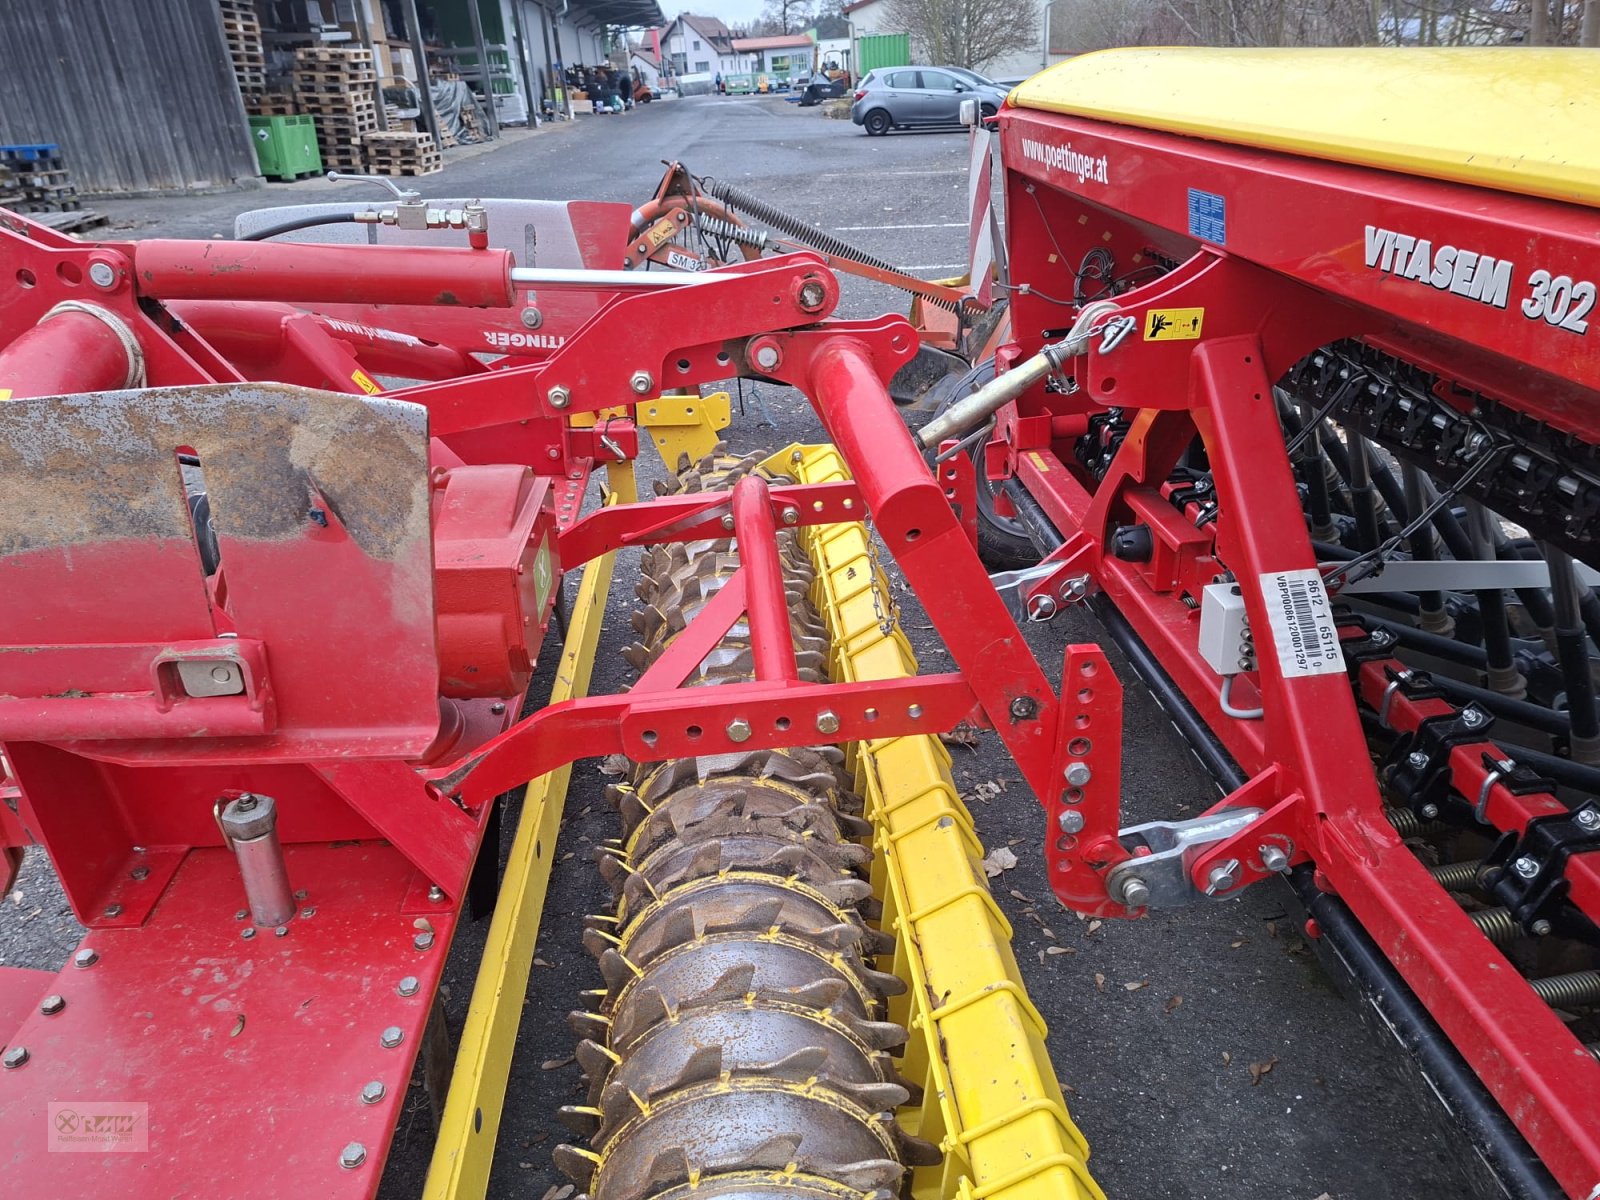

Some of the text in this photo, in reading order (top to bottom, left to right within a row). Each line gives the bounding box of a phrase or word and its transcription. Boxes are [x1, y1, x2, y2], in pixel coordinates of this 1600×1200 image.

[1022, 138, 1108, 184] www.poettinger.at
[671, 253, 688, 268] SM
[1365, 225, 1597, 335] VITASEM 302
[1276, 575, 1308, 670] VBP00086120001297
[1307, 580, 1323, 606] 8612
[1319, 626, 1338, 660] 65115
